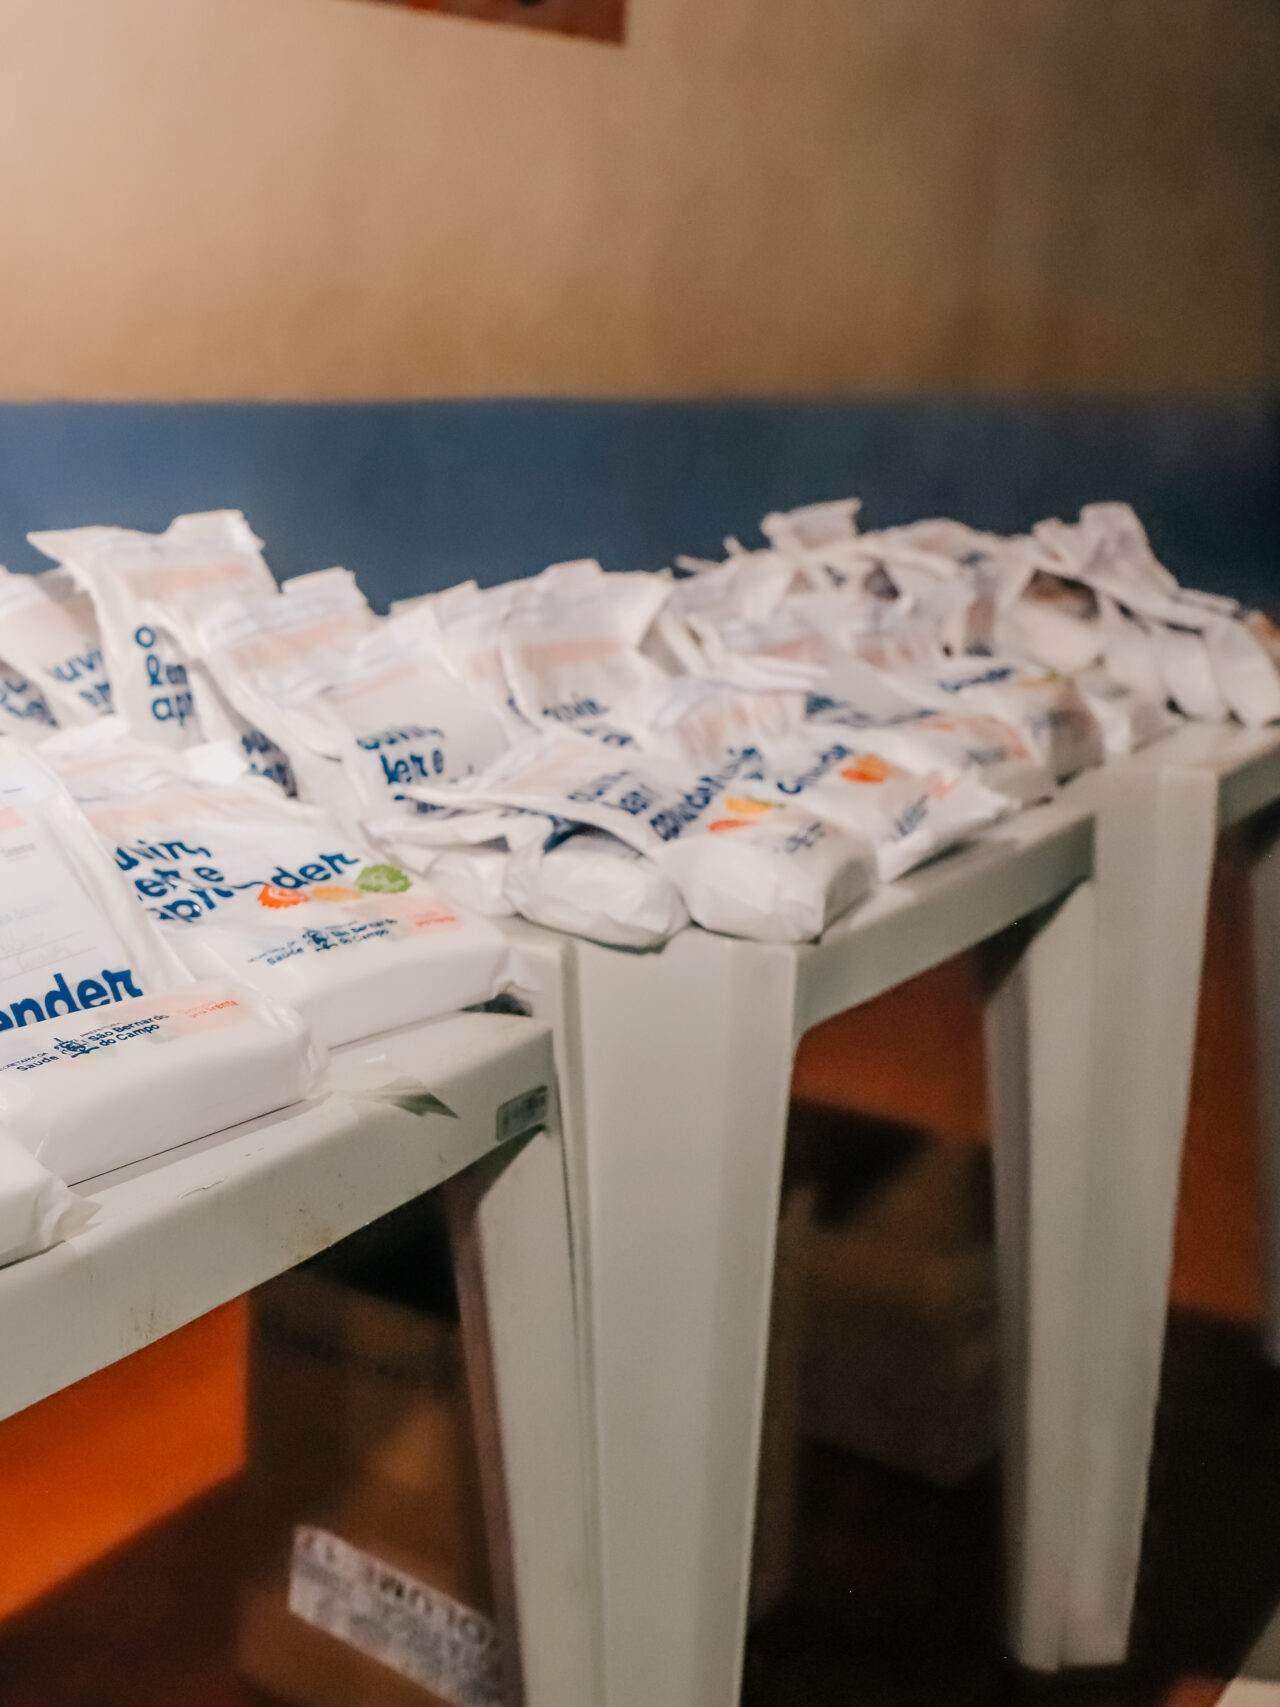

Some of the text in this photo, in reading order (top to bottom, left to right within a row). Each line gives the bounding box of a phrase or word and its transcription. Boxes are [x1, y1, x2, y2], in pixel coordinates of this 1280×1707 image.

[88, 1014, 170, 1042] São Bernardo
[99, 1023, 160, 1047] do Campo
